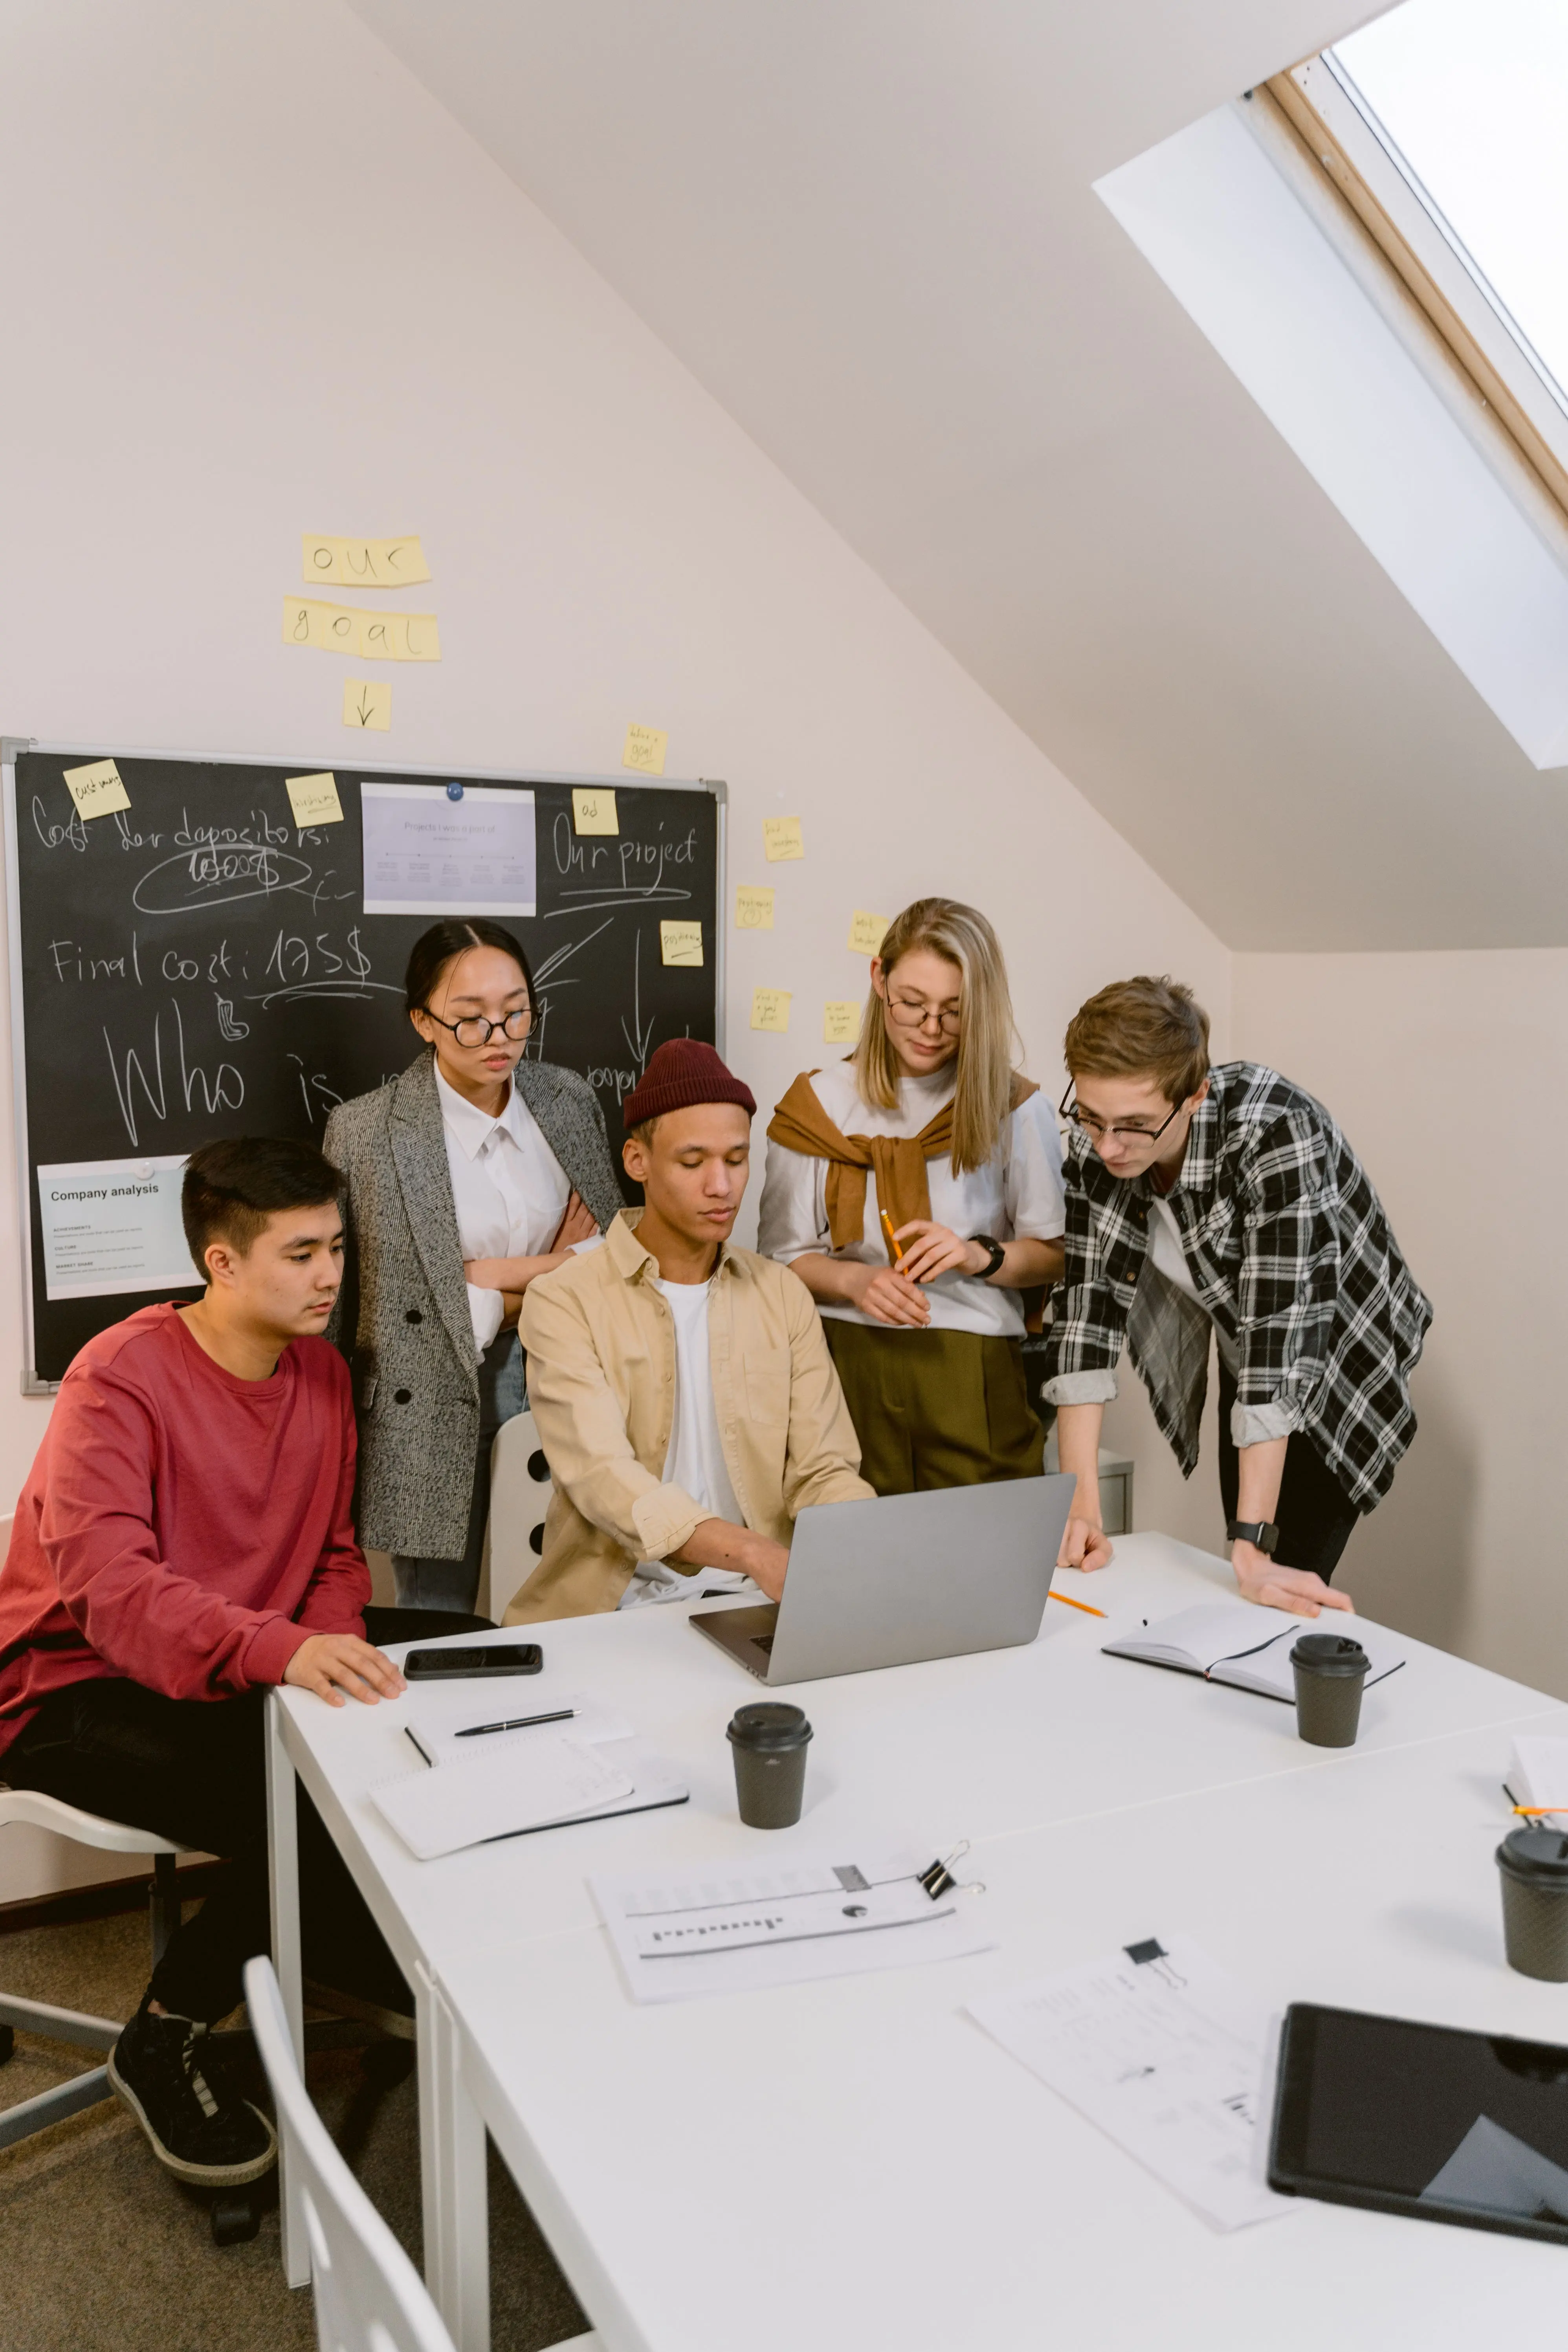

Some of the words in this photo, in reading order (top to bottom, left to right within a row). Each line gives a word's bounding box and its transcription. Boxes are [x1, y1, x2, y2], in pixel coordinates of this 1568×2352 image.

[293, 609, 422, 655] goal
[405, 821, 436, 833] Projects
[469, 825, 485, 835] part
[488, 824, 495, 833] of
[554, 812, 609, 874] Our
[619, 821, 698, 896] project
[48, 931, 142, 985] Final
[266, 925, 371, 988] 175$
[103, 998, 244, 1147] Who
[51, 1189, 107, 1202] Company
[111, 1183, 159, 1196] analysis
